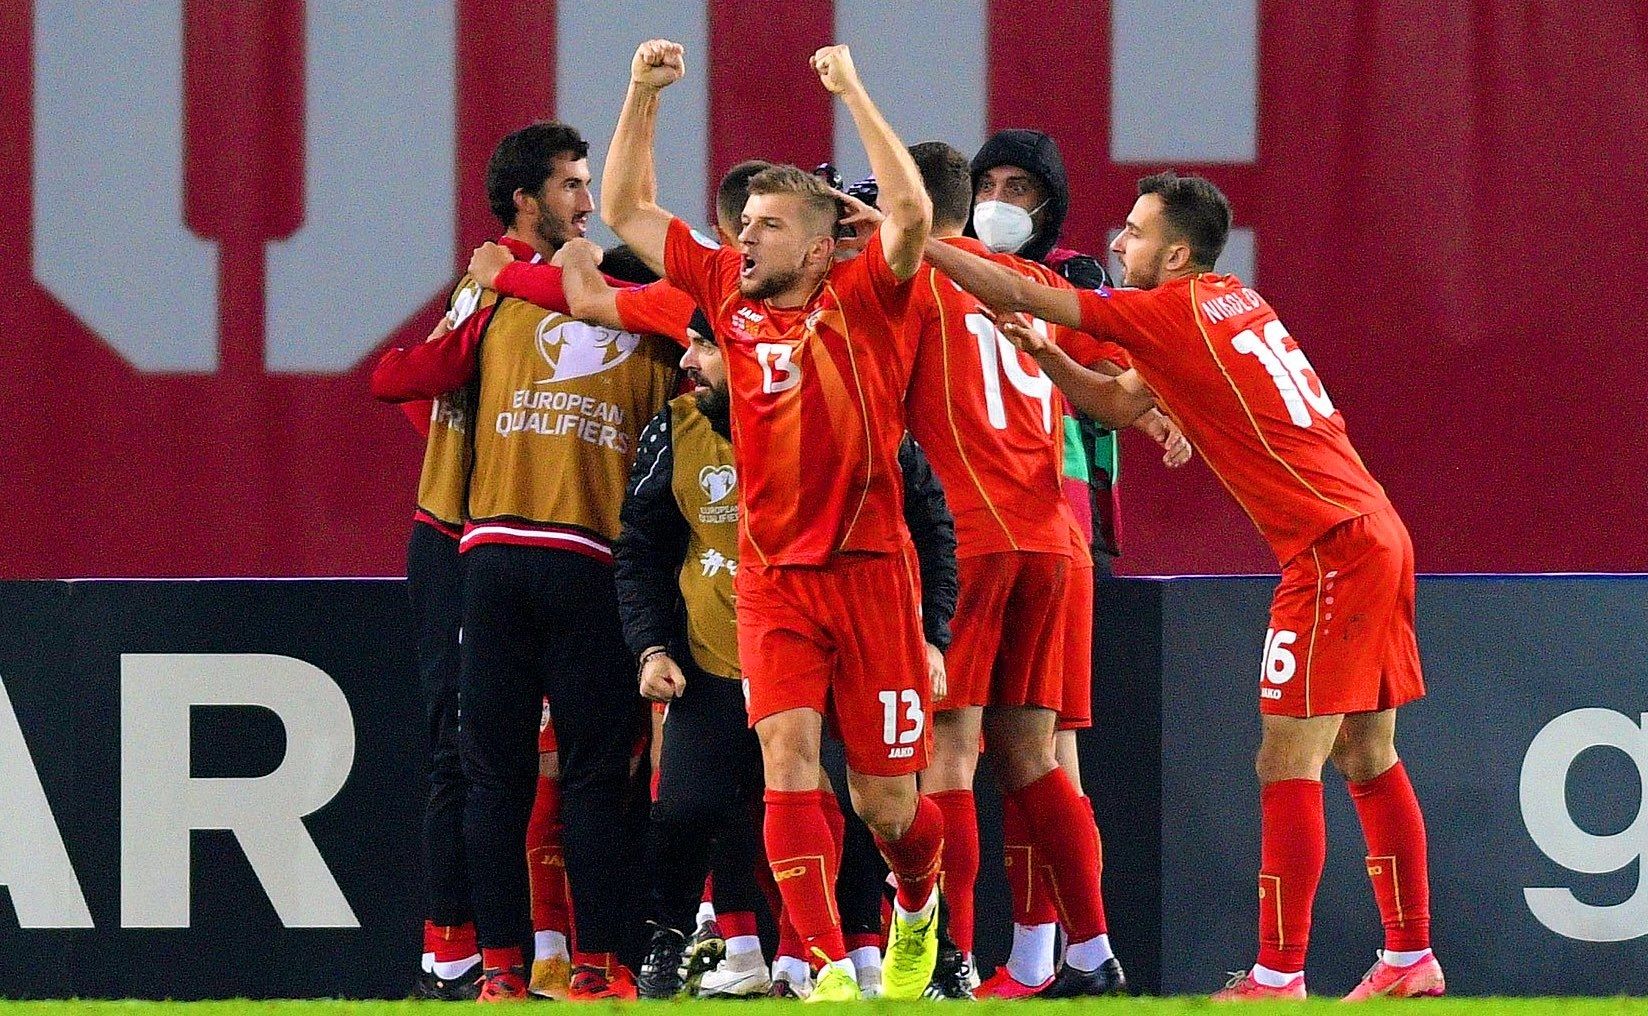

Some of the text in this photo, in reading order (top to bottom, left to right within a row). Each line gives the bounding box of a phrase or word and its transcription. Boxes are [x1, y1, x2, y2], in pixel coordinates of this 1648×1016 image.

[755, 343, 801, 394] 13
[965, 313, 1053, 435] 14
[1231, 319, 1335, 428] 16
[495, 411, 631, 453] QUALIFIERS
[513, 389, 624, 425] EUROPEAN
[879, 689, 924, 744] 13
[888, 747, 914, 758] JAKO
